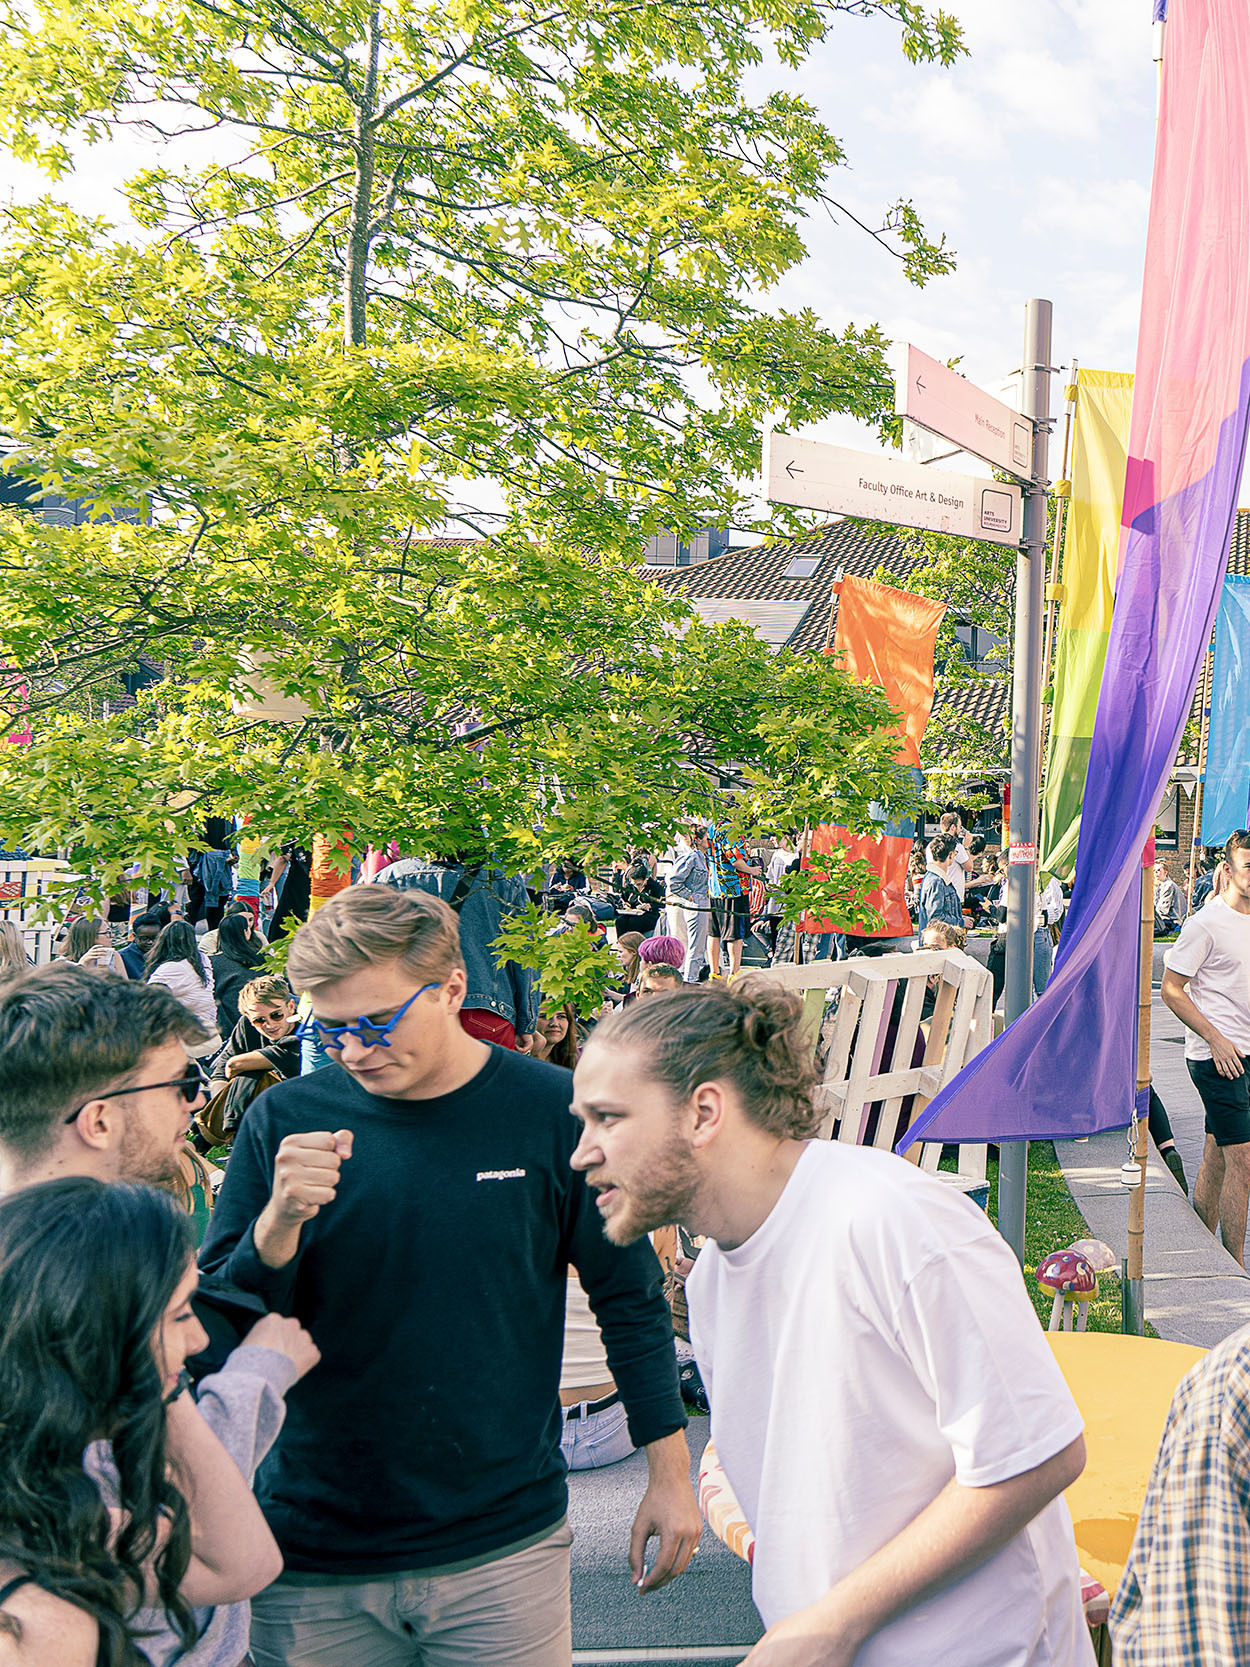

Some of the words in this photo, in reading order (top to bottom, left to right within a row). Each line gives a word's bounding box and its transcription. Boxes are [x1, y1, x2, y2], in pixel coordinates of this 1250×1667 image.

[858, 477, 889, 495] Faculty
[890, 484, 913, 499] Office
[915, 489, 928, 502] Art
[929, 492, 936, 502] &
[938, 493, 964, 510] Design
[476, 1168, 526, 1182] patagonia
